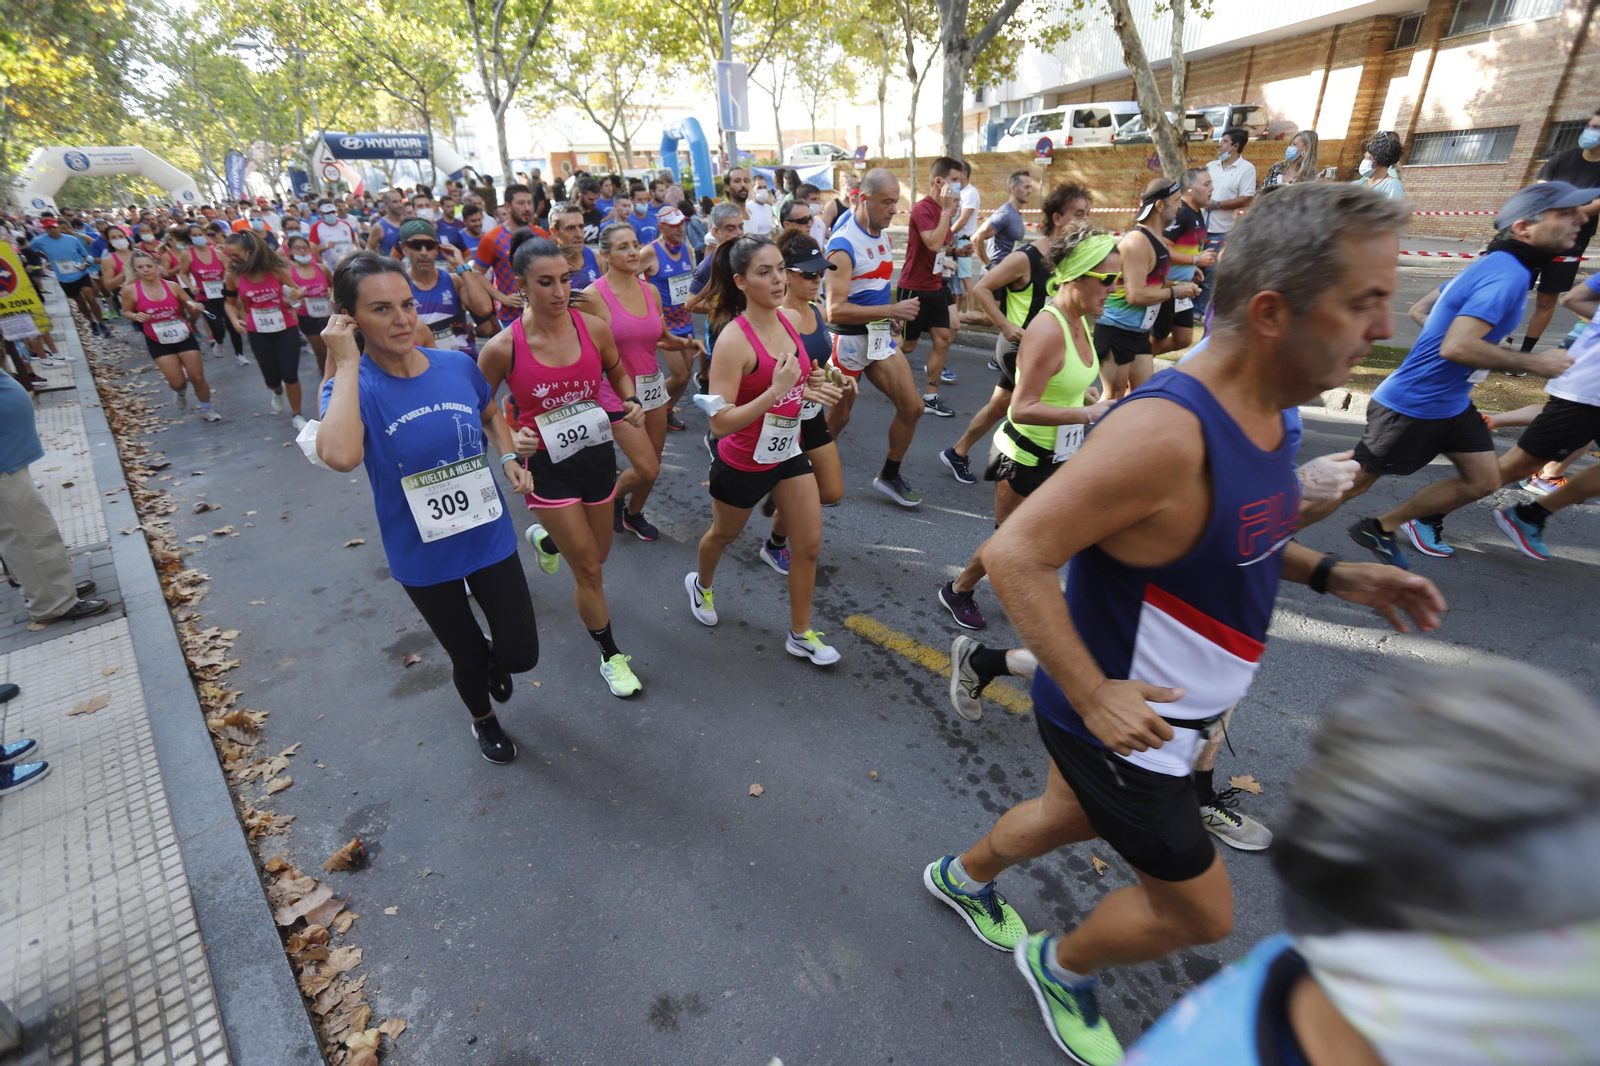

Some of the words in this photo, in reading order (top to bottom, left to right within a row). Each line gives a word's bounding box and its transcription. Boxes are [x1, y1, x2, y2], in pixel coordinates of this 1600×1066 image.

[364, 138, 422, 148] HYUNDAI
[675, 286, 688, 297] 362
[8, 298, 35, 308] ZONA
[259, 318, 275, 326] 384
[162, 329, 179, 338] 403
[552, 380, 596, 389] HYROX
[542, 386, 593, 409] Queen
[643, 386, 662, 401] 222
[396, 405, 433, 424] VUELTA
[433, 403, 442, 412] A
[441, 402, 473, 415] HUELVA
[549, 409, 572, 422] VUELTA
[576, 402, 597, 412] HUELVA
[557, 424, 589, 449] 392
[767, 435, 794, 452] 381
[408, 478, 419, 488] 34
[419, 468, 449, 486] VUELTA
[449, 466, 456, 477] A
[455, 458, 483, 475] HUELVA
[427, 489, 470, 521] 309
